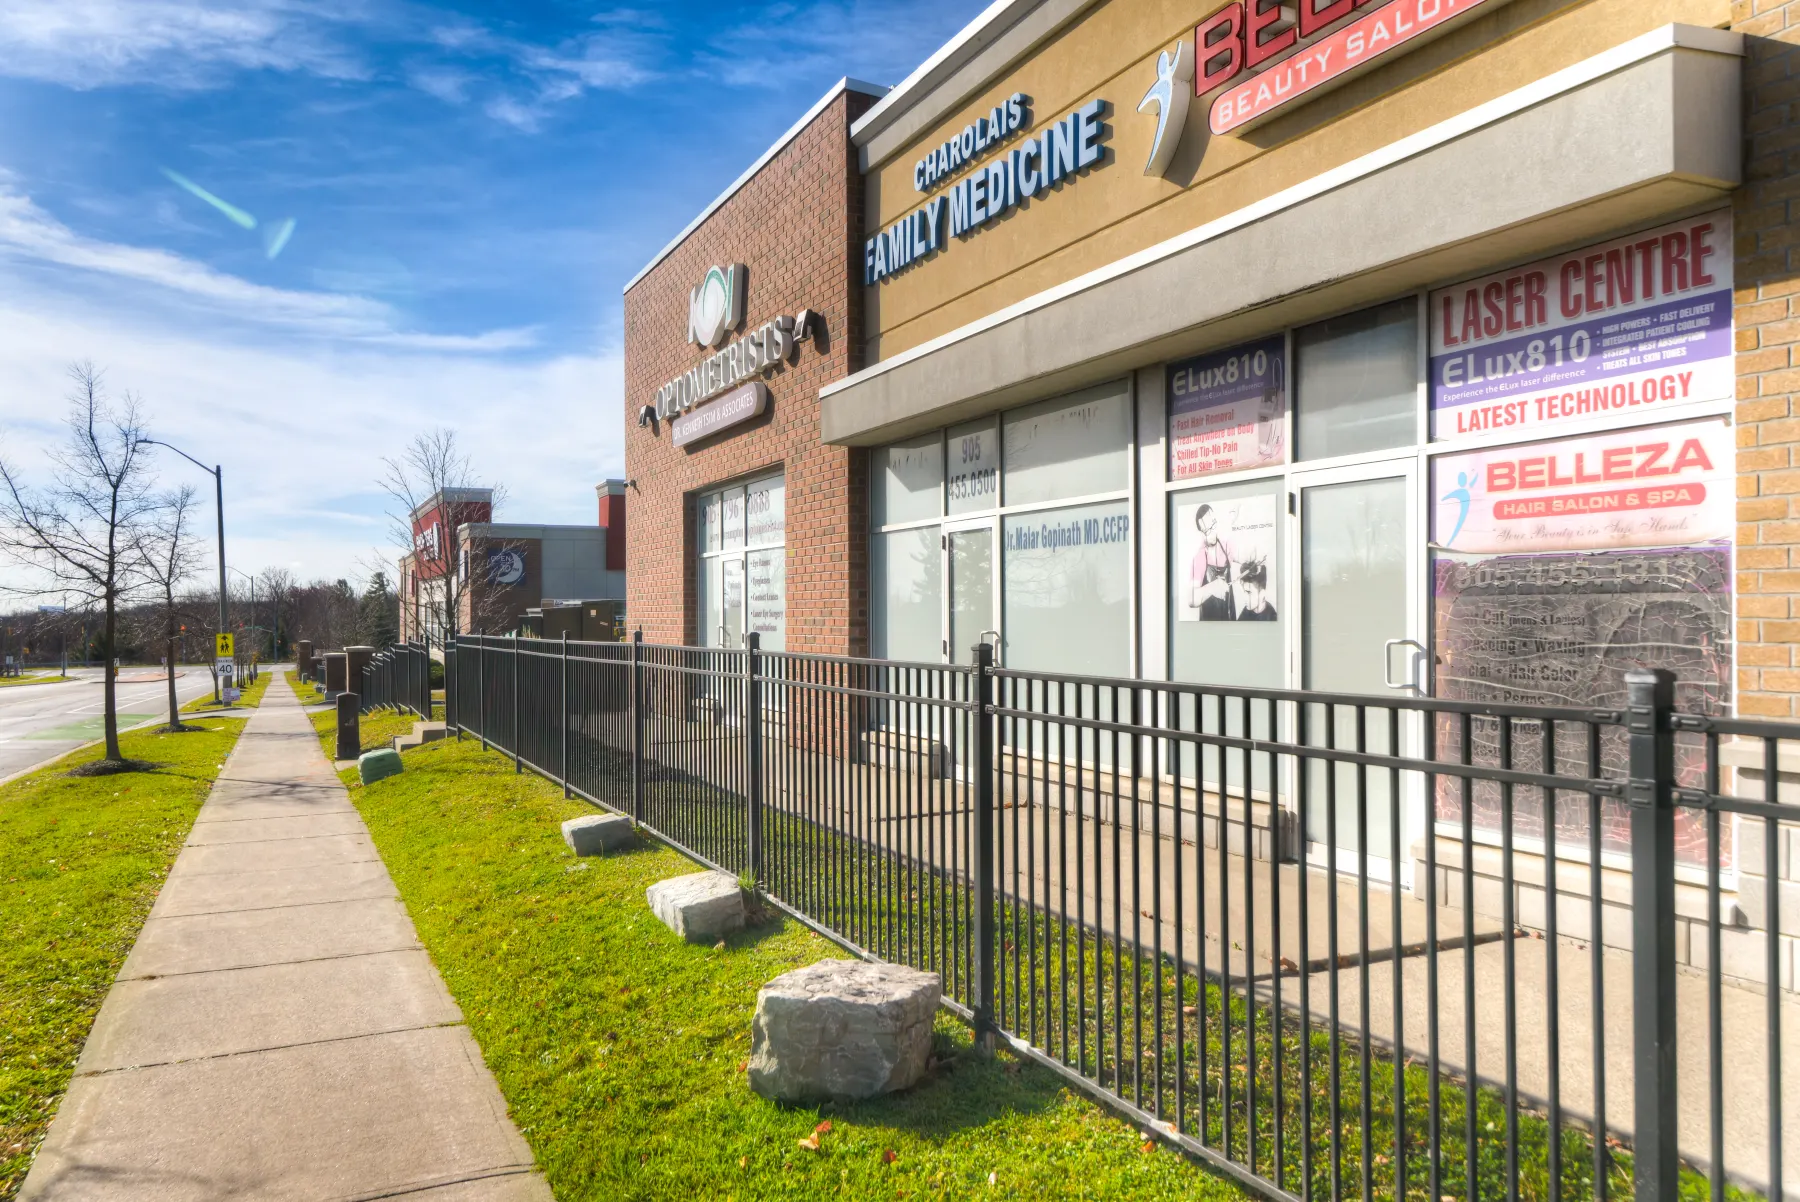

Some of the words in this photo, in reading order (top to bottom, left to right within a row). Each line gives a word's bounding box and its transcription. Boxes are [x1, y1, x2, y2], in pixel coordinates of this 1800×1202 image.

[1218, 47, 1333, 126] BEAUTY
[1346, 0, 1456, 59] SALO
[914, 92, 1026, 192] CHAROLAIS
[866, 196, 945, 285] FAMILY
[950, 99, 1104, 238] MEDICINE
[1443, 271, 1547, 348] LASER
[1560, 223, 1713, 320] CENTRE
[1602, 324, 1619, 334] HIGH
[1621, 317, 1651, 331] POWERS
[1660, 311, 1678, 323] FAST
[1679, 302, 1715, 319] DELIVERY
[1602, 330, 1644, 347] INTEGRATED
[1645, 324, 1675, 338] PATIENT
[1676, 316, 1711, 331] COOLING
[1638, 341, 1657, 352] BEST
[1658, 331, 1706, 348] ABSORPTION
[655, 315, 788, 421] OPTOMETRISTS
[1602, 358, 1628, 371] TREATS
[1629, 355, 1642, 366] ALL
[1643, 351, 1661, 363] SKIN
[1662, 347, 1687, 360] TONES
[1443, 388, 1484, 402] Experience
[1485, 384, 1498, 395] the
[1499, 382, 1519, 391] ELux
[1520, 377, 1541, 388] laser
[1543, 369, 1586, 383] difference
[682, 415, 703, 436] KENNETH
[703, 409, 716, 427] TSIM
[721, 391, 754, 419] ASSOCIATES
[1457, 400, 1528, 434] LATEST
[1535, 371, 1694, 421] TECHNOLOGY
[1177, 418, 1189, 431] Fast
[1190, 416, 1205, 428] Hair
[1205, 409, 1234, 426] Removal
[1177, 433, 1192, 446] Treat
[1193, 427, 1225, 443] Anywhere
[1227, 426, 1236, 437] on
[1237, 422, 1254, 436] Body
[962, 435, 981, 464] 905
[1177, 447, 1198, 461] Chilled
[1200, 443, 1221, 458] Tip-No
[1222, 441, 1238, 453] Pain
[1177, 464, 1187, 475] For
[1188, 462, 1197, 473] All
[1199, 460, 1213, 473] Skin
[1214, 458, 1233, 469] Tones
[1486, 438, 1715, 493] BELLEZA
[702, 503, 717, 526] 905
[723, 497, 739, 520] 796
[747, 489, 770, 515] 0888
[1503, 501, 1546, 516] HAIR
[1552, 494, 1619, 512] SALON
[1625, 493, 1640, 506] &
[1646, 488, 1692, 504] SPA
[1041, 520, 1082, 553] Gopinath
[1530, 523, 1574, 540] Beauty
[490, 554, 511, 563] OPEN
[1534, 638, 1586, 657] Waxing
[218, 664, 232, 674] 40
[1508, 663, 1536, 680] Hair
[1540, 665, 1578, 682] Color
